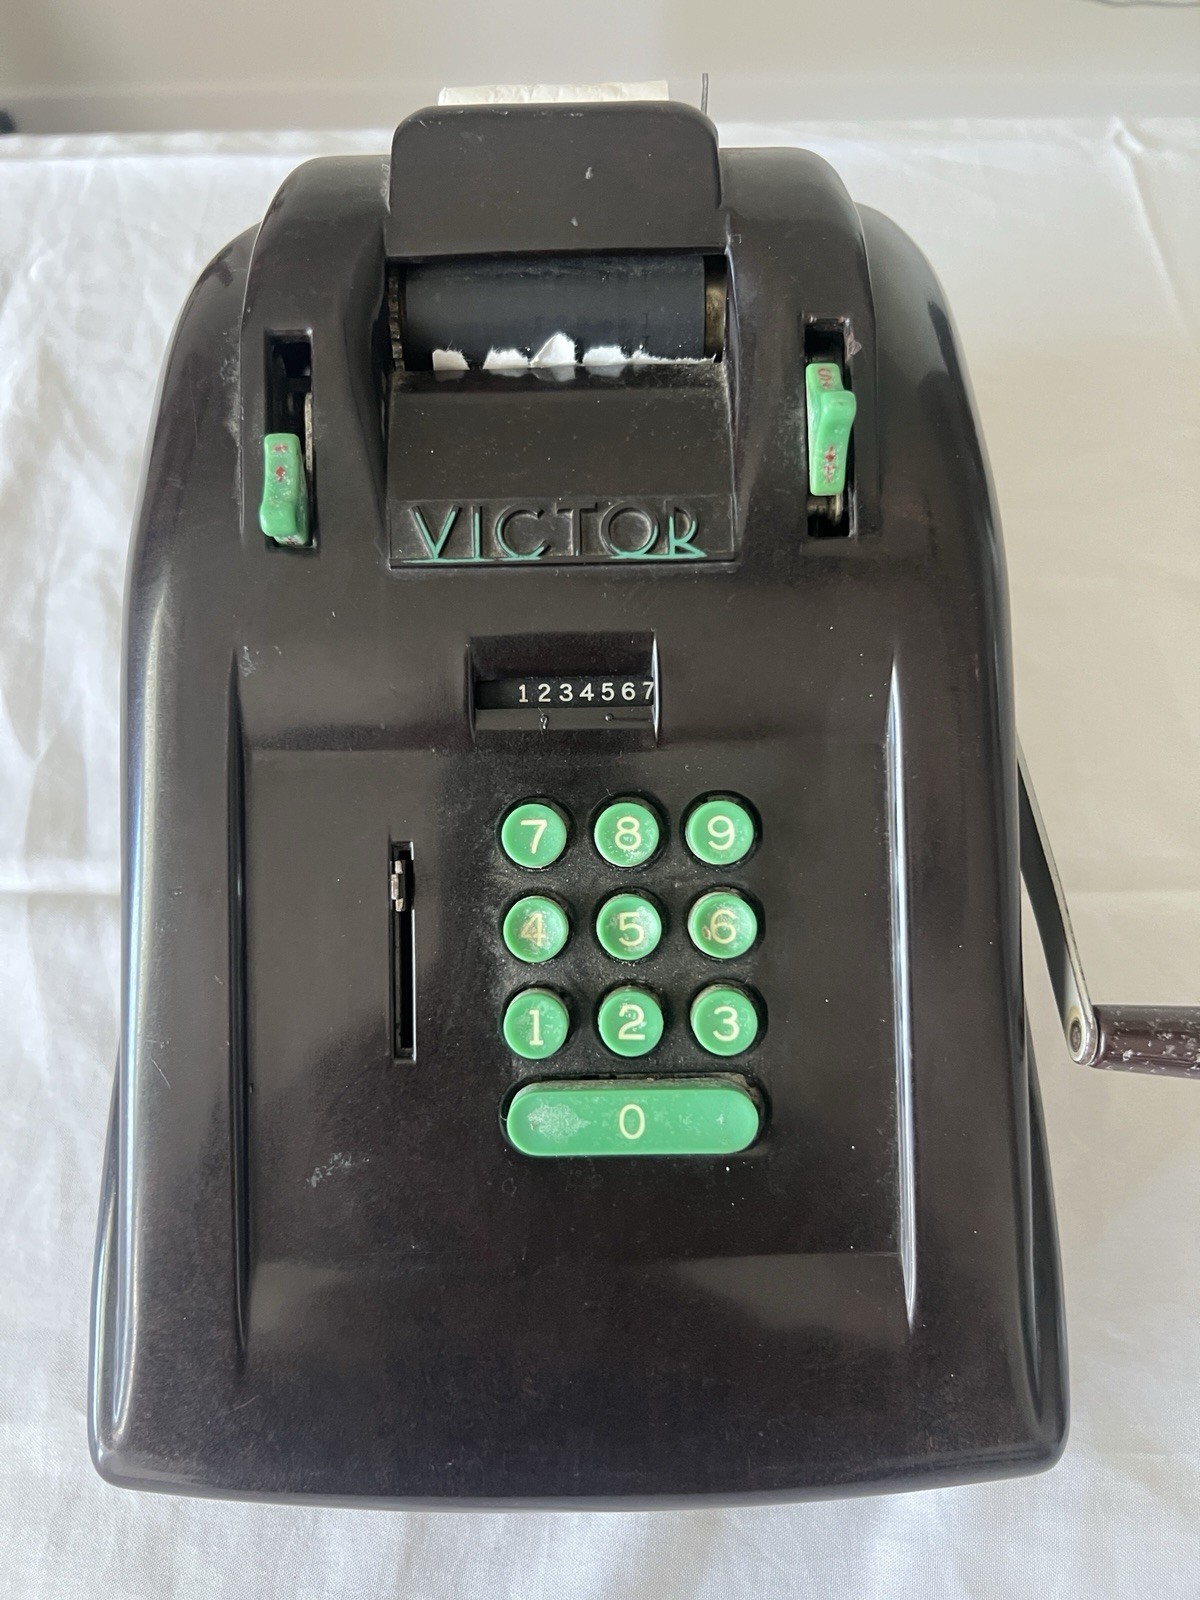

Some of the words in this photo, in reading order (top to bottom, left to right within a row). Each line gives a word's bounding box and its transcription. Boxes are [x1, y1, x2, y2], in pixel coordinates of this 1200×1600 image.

[404, 503, 707, 562] VICTOR
[520, 819, 548, 855] 7
[614, 815, 642, 852] 8
[707, 814, 735, 851] 9
[520, 911, 546, 947] 4
[618, 911, 645, 947] 5
[710, 908, 737, 945] 6
[529, 1008, 544, 1046] 1
[617, 1003, 646, 1041] 2
[712, 1005, 740, 1042] 3
[618, 1103, 646, 1140] 0
